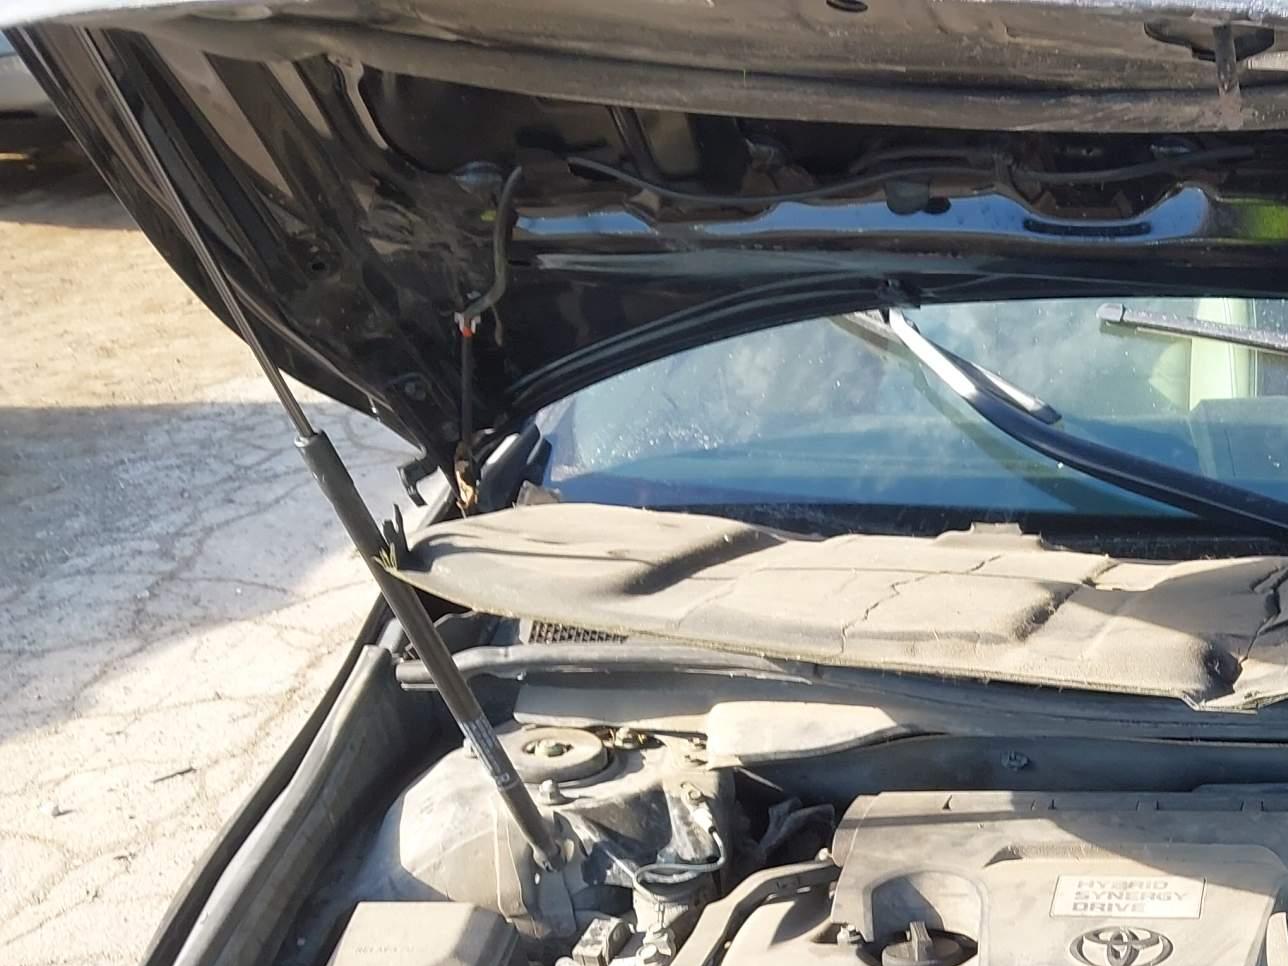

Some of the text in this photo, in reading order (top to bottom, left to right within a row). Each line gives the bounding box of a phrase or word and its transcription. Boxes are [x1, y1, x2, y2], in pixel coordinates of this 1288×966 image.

[1077, 880, 1169, 890] HYBRID
[1074, 891, 1187, 901] SYNERGY
[1072, 902, 1146, 912] DRIVE
